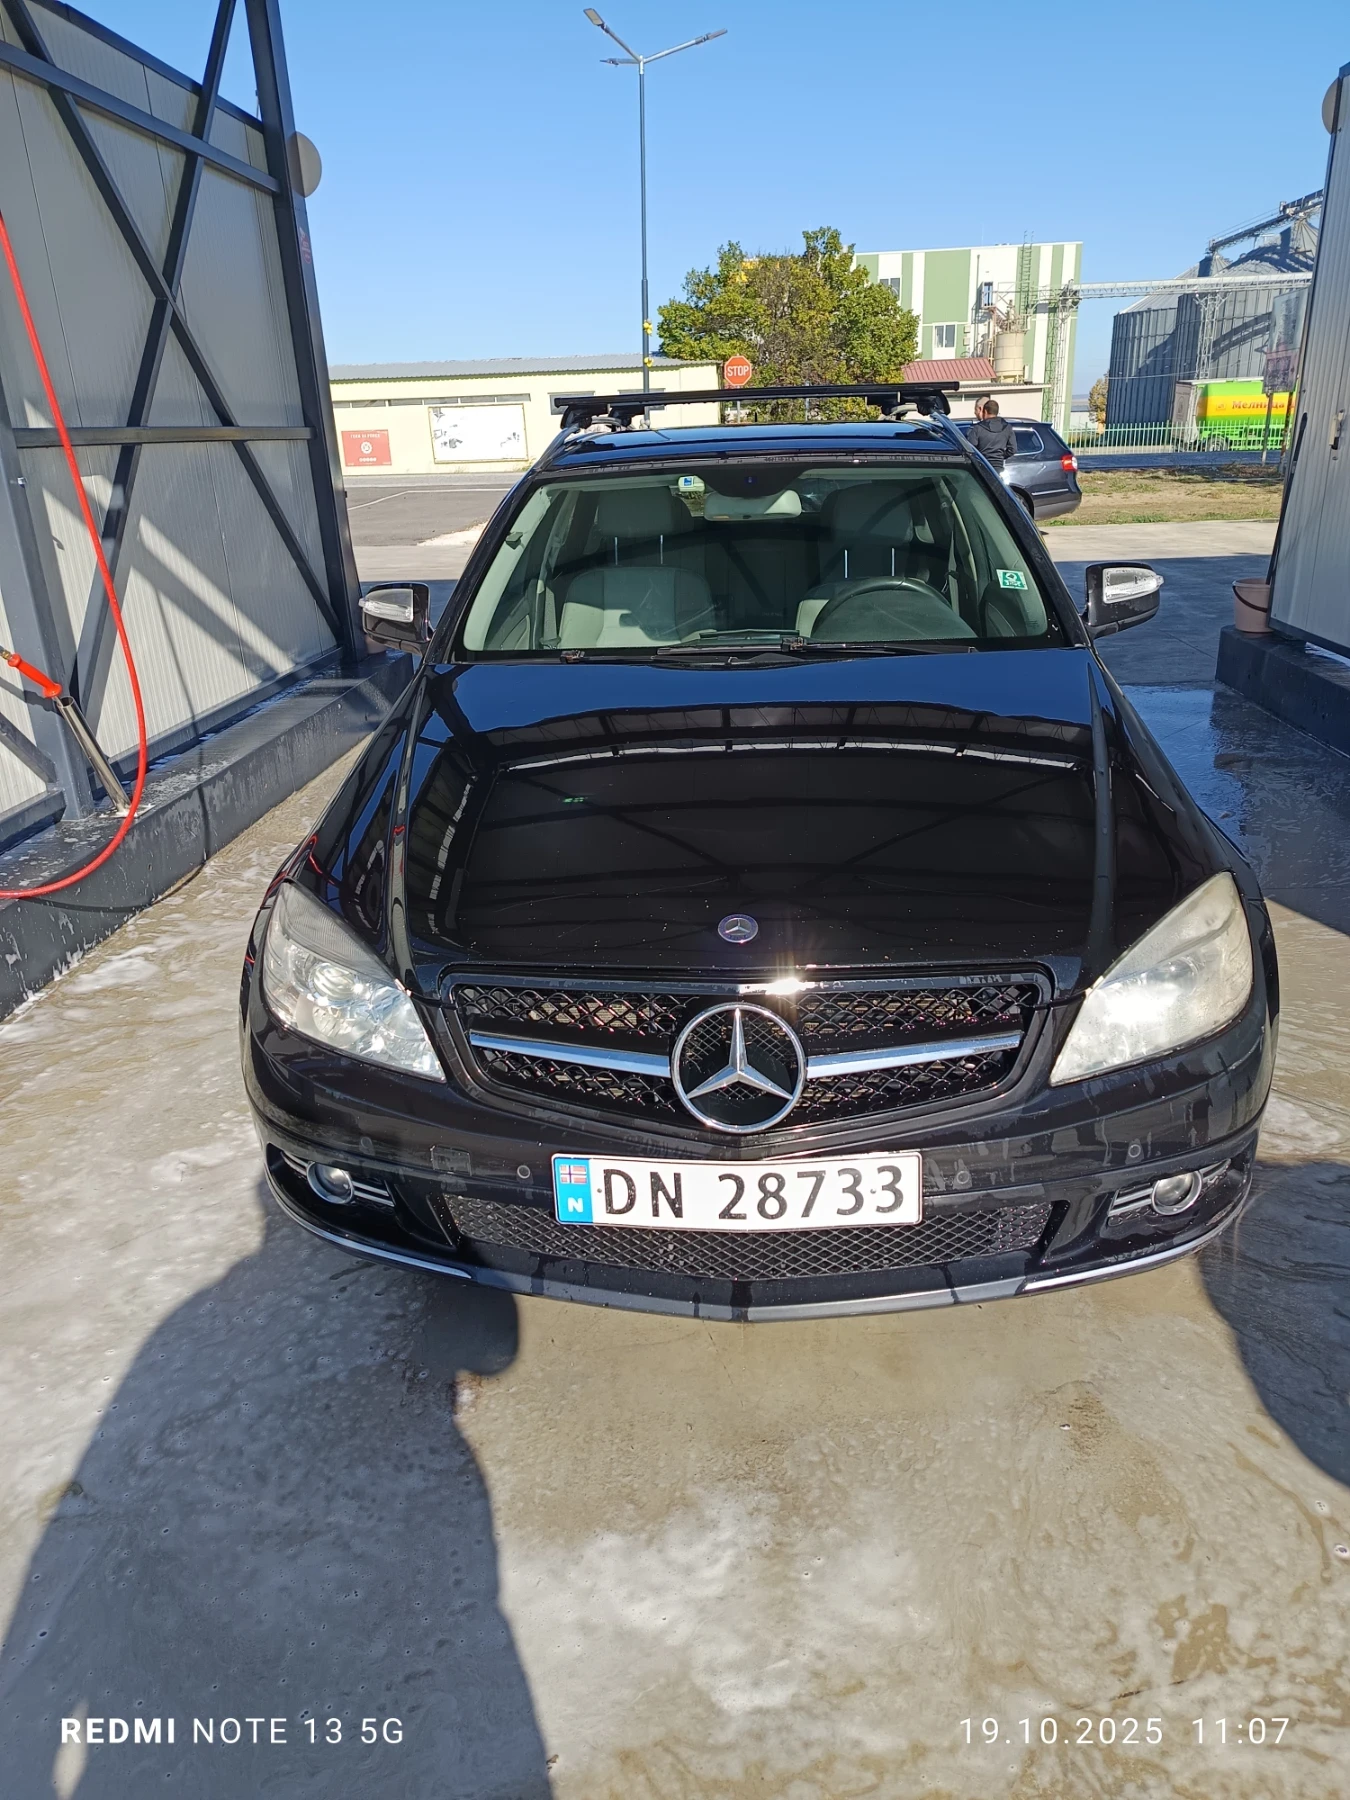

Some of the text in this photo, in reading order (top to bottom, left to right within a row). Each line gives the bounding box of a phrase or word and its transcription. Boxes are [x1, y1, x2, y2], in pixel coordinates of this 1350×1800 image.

[727, 365, 750, 377] STOP
[603, 1165, 904, 1220] DN 28733
[567, 1196, 584, 1213] N
